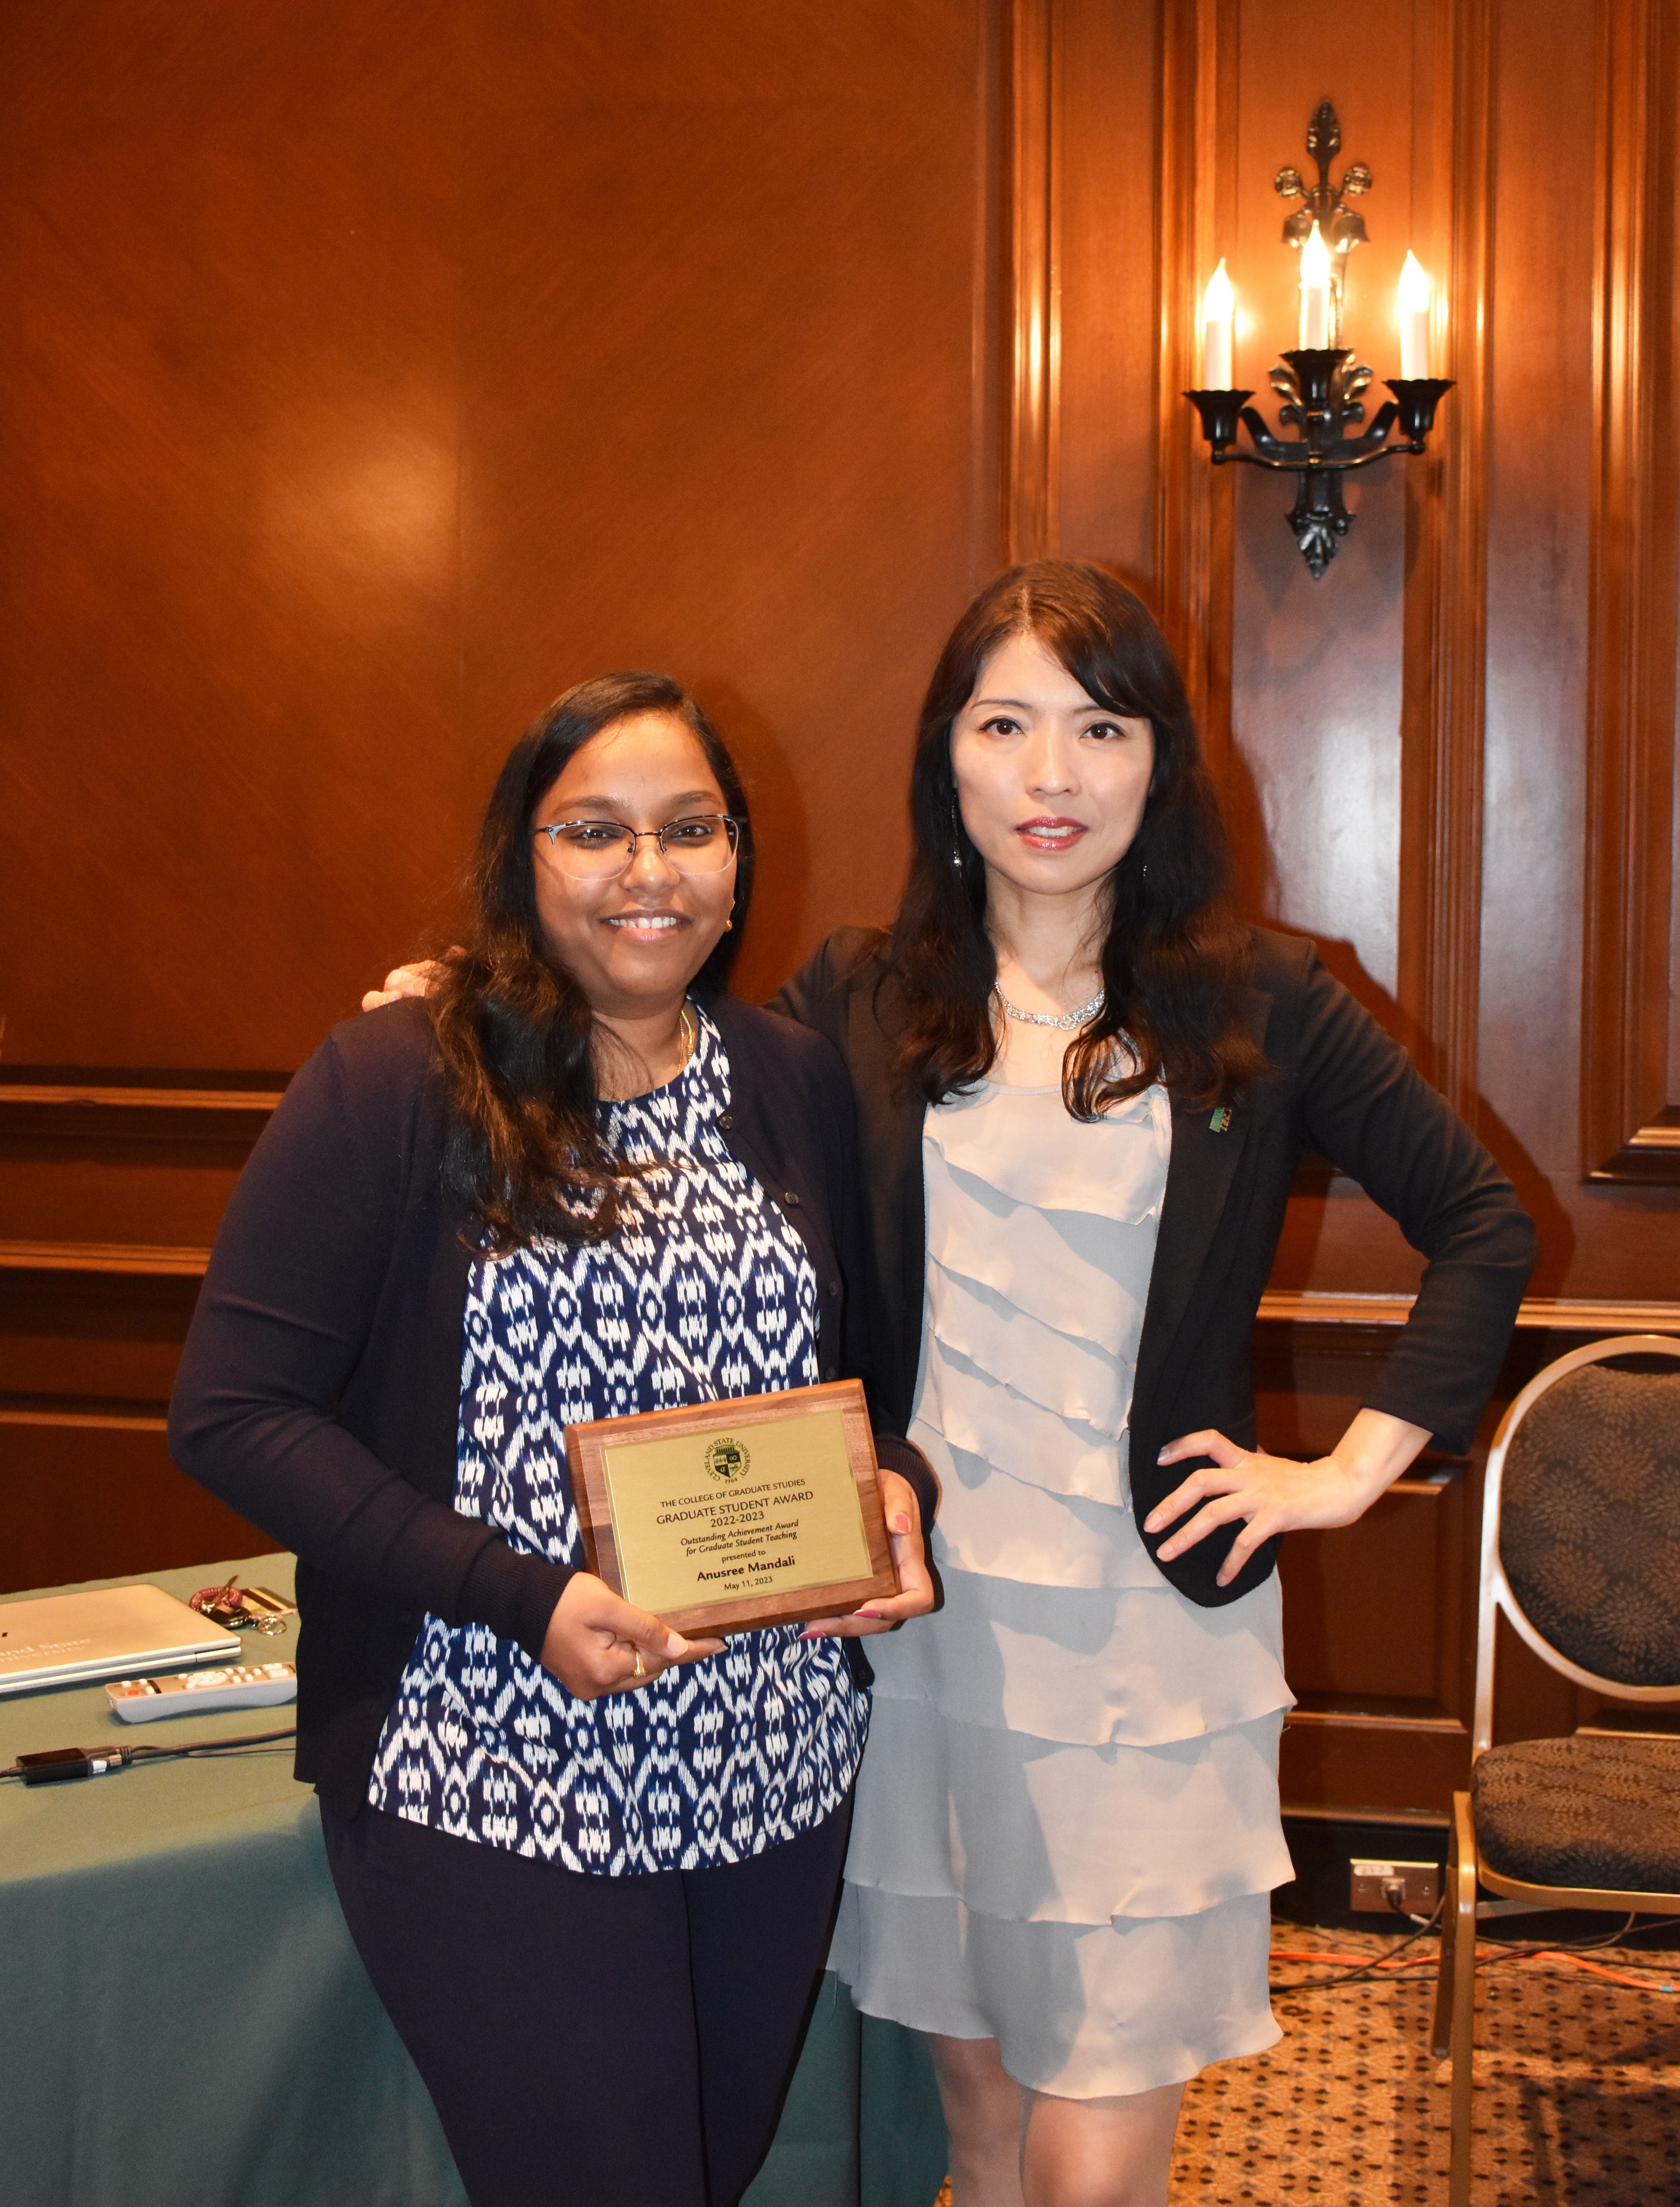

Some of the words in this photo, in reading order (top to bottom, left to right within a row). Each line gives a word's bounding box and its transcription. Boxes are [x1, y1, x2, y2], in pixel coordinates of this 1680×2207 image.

[704, 1445, 720, 1481] CLEVELAND
[714, 1438, 734, 1446] STATE
[736, 1441, 750, 1477] UNIVERSITY
[660, 1500, 677, 1508] THE
[679, 1493, 714, 1505] COLLEGE
[716, 1491, 727, 1499] OF
[728, 1484, 771, 1497] GRADUATE
[773, 1479, 806, 1489] STUDIES
[657, 1506, 717, 1524] GRADUATE
[719, 1498, 770, 1514] STUDENT
[773, 1491, 814, 1506] AWARD
[710, 1511, 765, 1527] 2022-2023
[681, 1533, 726, 1546] Outstanding
[728, 1524, 773, 1538] Achievement
[775, 1519, 798, 1530] Award
[686, 1547, 696, 1557] for
[699, 1542, 733, 1553] Graduate
[735, 1536, 763, 1547] Student
[766, 1531, 798, 1542] Teaching
[697, 1567, 744, 1581] Anusree
[748, 1555, 796, 1573] Mandali
[722, 1550, 756, 1564] presented
[724, 1583, 739, 1591] May
[755, 1576, 773, 1585] 2023
